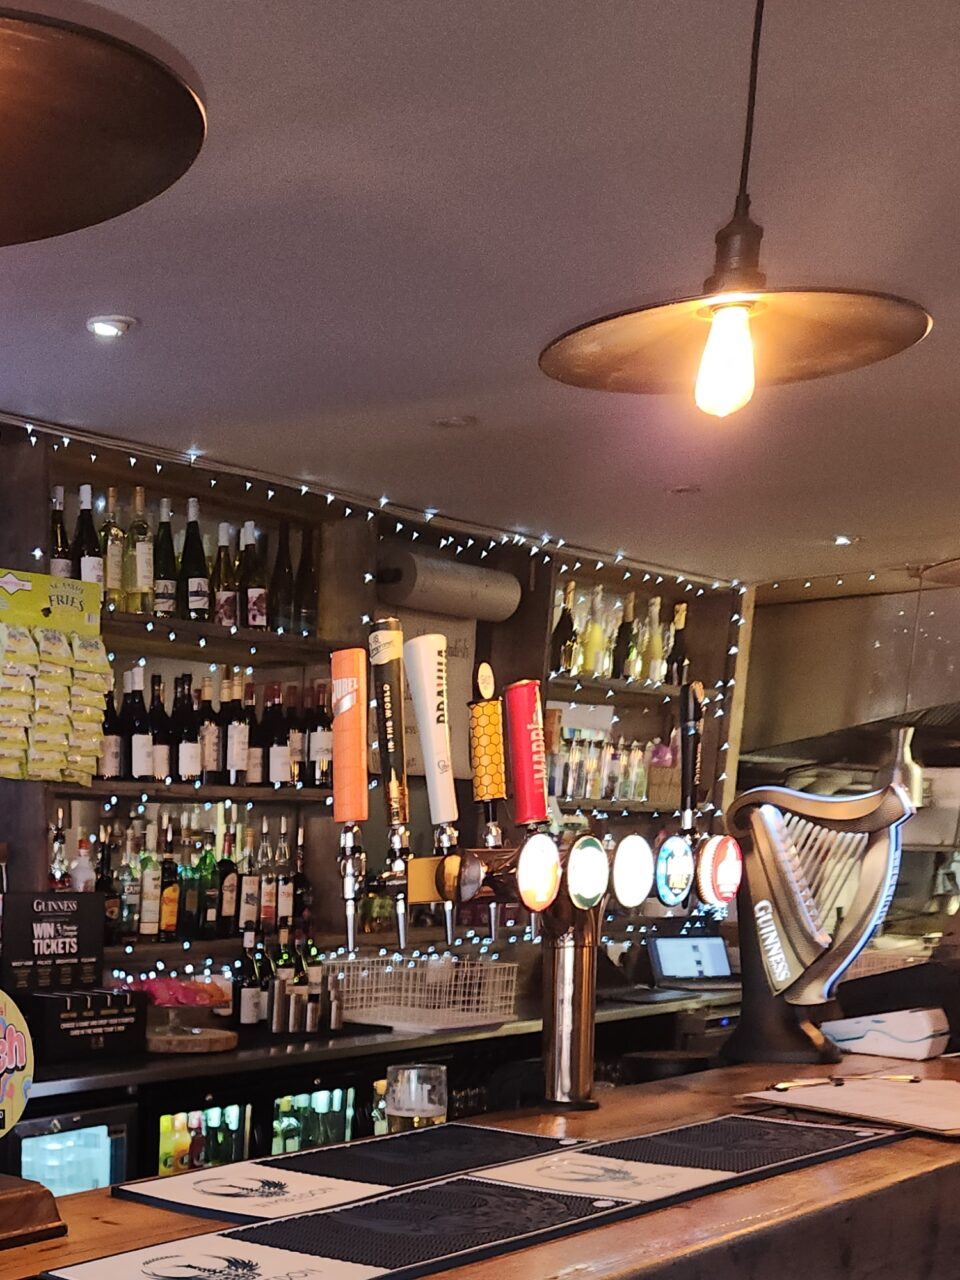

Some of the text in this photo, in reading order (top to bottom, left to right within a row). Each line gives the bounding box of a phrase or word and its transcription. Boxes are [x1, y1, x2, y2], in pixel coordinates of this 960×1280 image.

[48, 594, 85, 612] FRIES
[383, 683, 392, 718] WORLD
[33, 899, 78, 912] GUINNESS
[32, 922, 55, 939] WIN
[32, 937, 78, 955] TICKETS
[754, 899, 791, 982] GUINNESS
